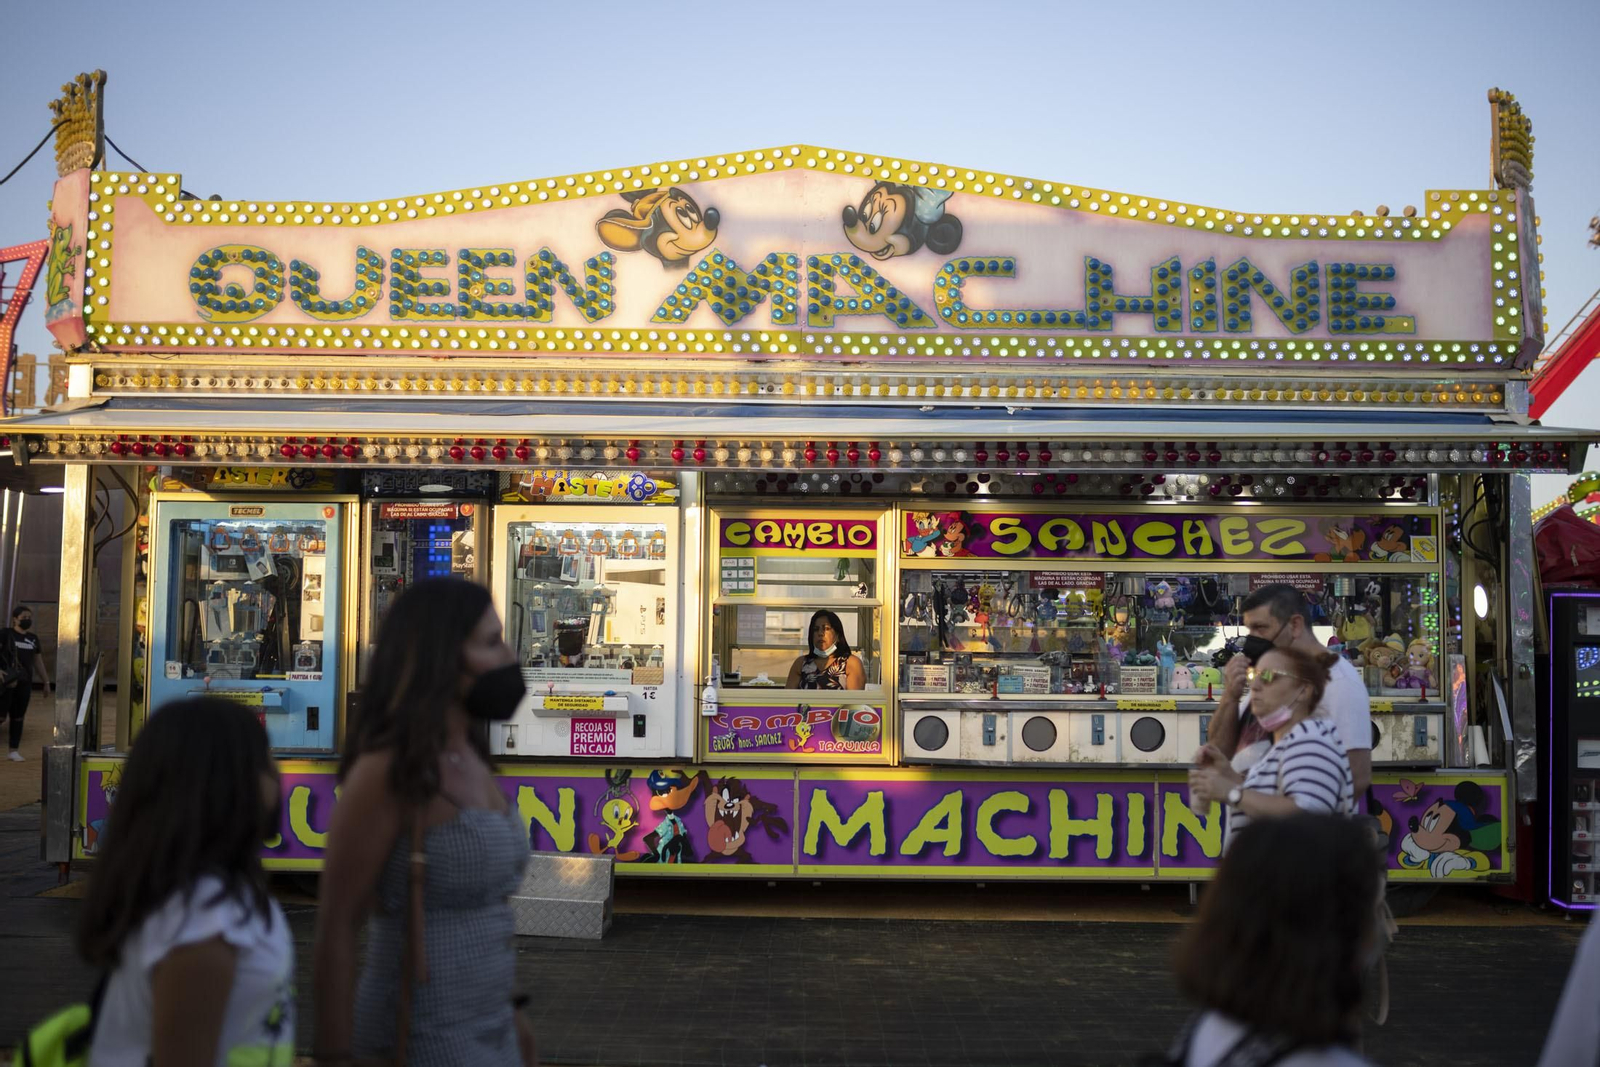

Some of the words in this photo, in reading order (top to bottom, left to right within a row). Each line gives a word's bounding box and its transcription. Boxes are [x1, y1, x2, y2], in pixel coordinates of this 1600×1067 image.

[189, 244, 616, 325] QUEEN
[653, 253, 1417, 335] MACHINE
[530, 476, 629, 497] MASTER
[725, 521, 872, 549] CAMBIO
[989, 517, 1306, 556] SANCHEZ
[573, 732, 615, 743] PREMIO
[575, 723, 602, 732] RECOJA
[603, 723, 614, 732] SU
[573, 744, 588, 753] EN
[588, 744, 615, 754] CAJA
[818, 740, 881, 752] TAQUILLA
[803, 788, 1218, 859] MACHIN
